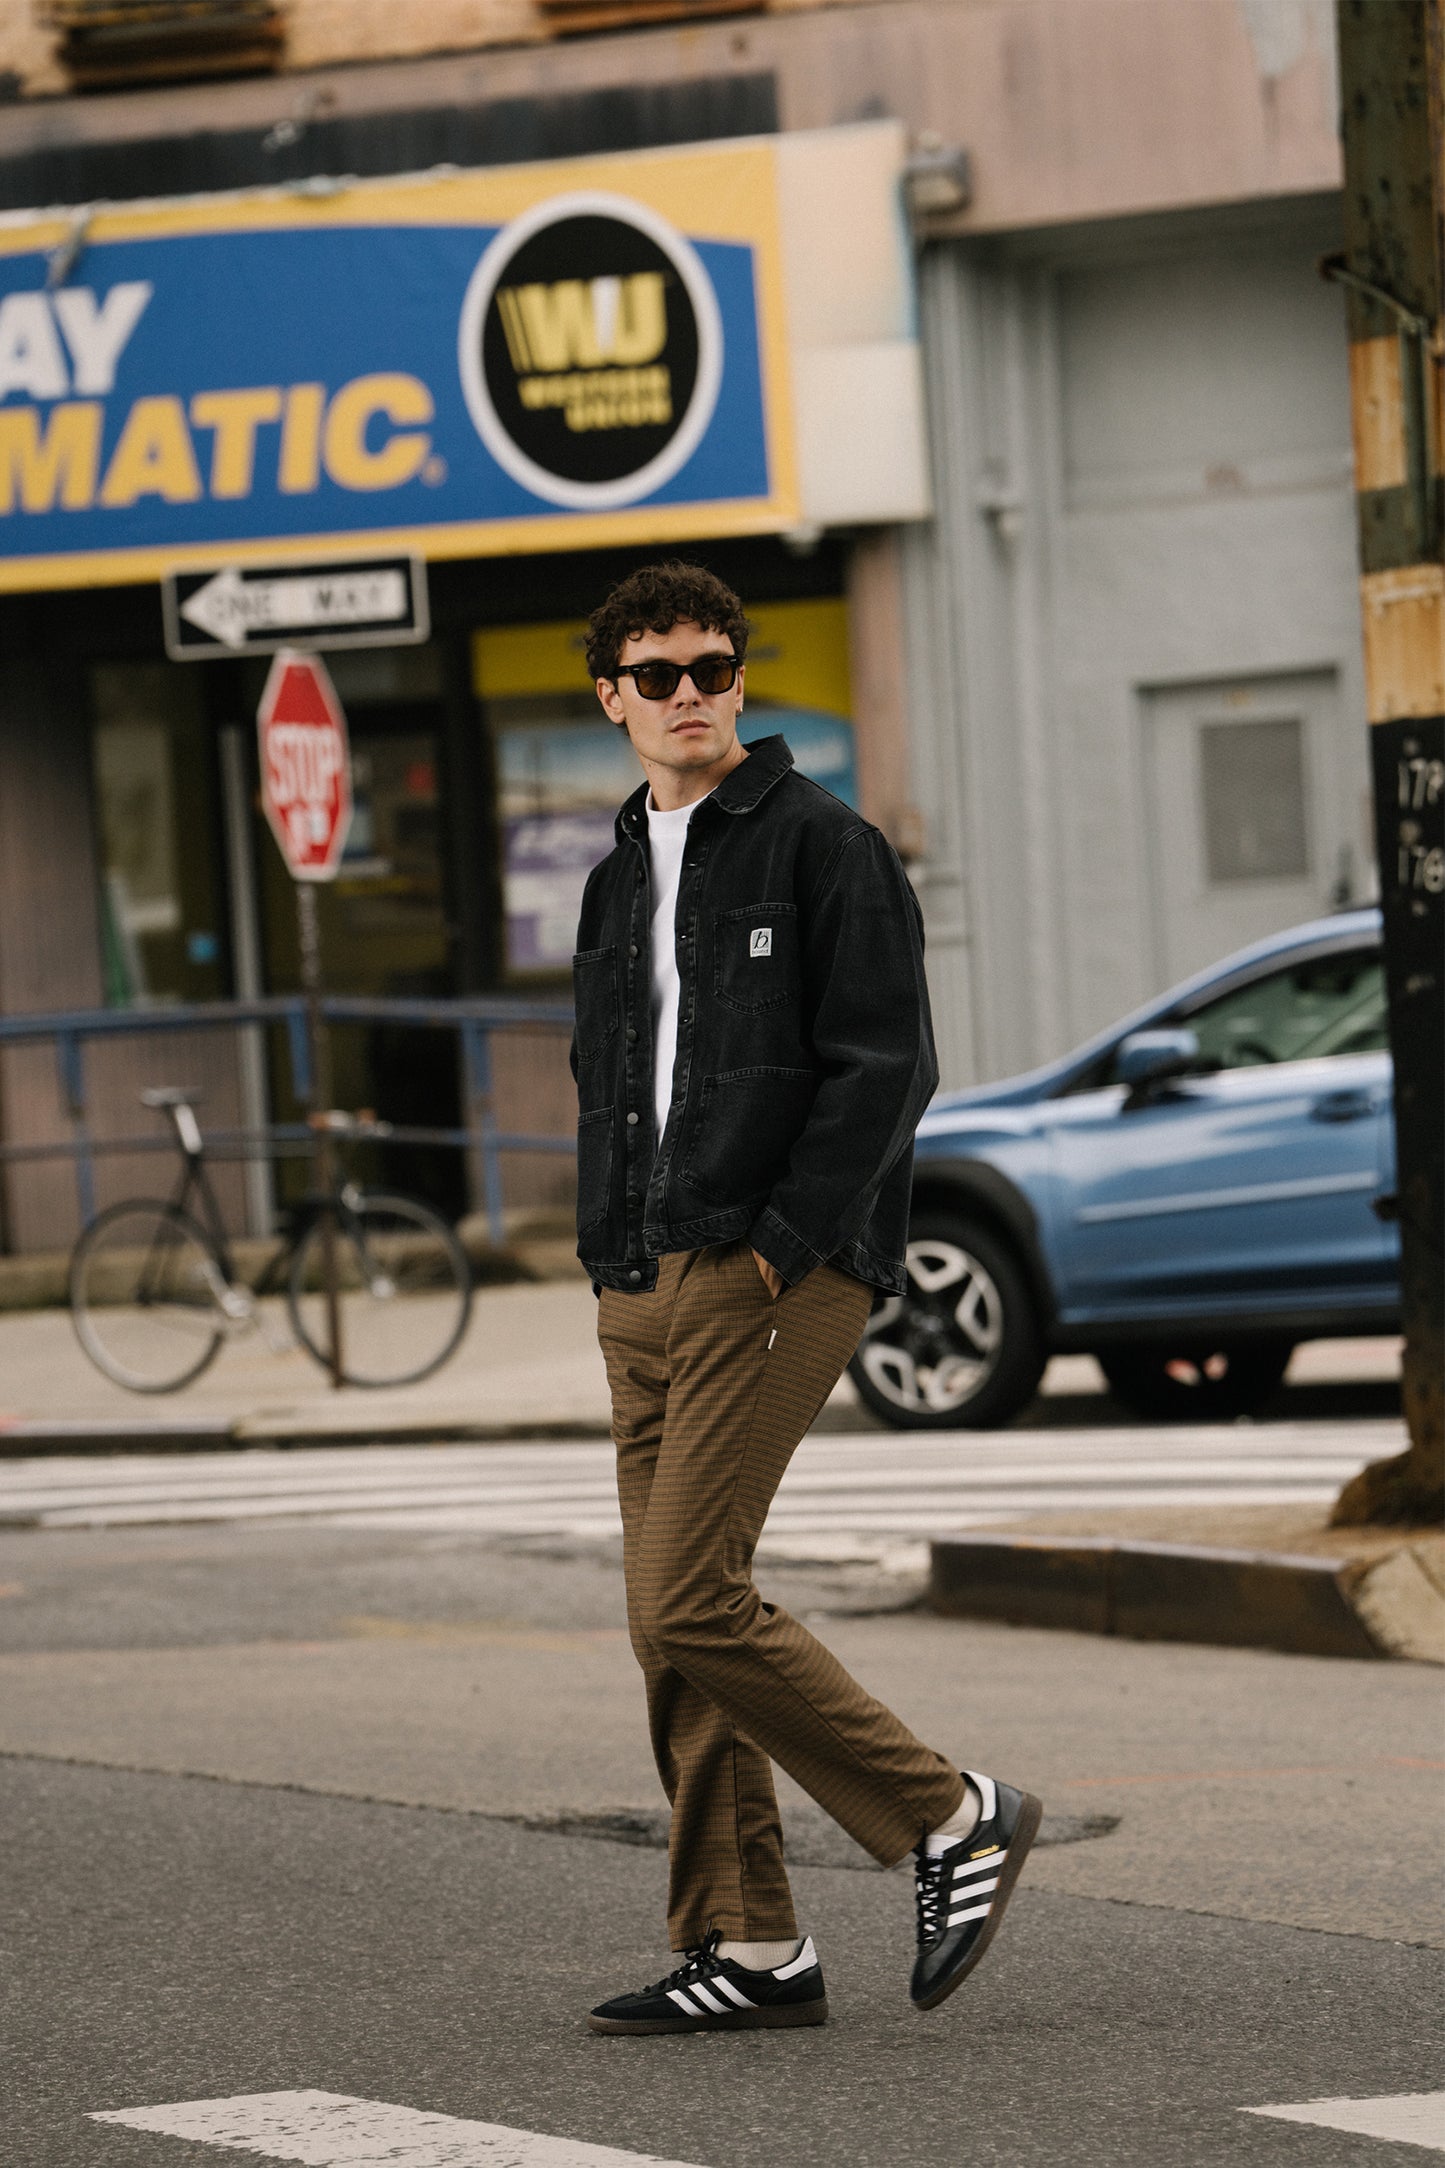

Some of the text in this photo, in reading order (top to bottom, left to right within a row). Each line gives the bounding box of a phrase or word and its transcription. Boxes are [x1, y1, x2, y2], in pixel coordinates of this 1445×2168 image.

[0, 280, 154, 400] AY
[498, 271, 667, 372] WU
[0, 371, 434, 516] MATIC
[207, 577, 385, 627] ONE WAY
[268, 723, 343, 806] STOP
